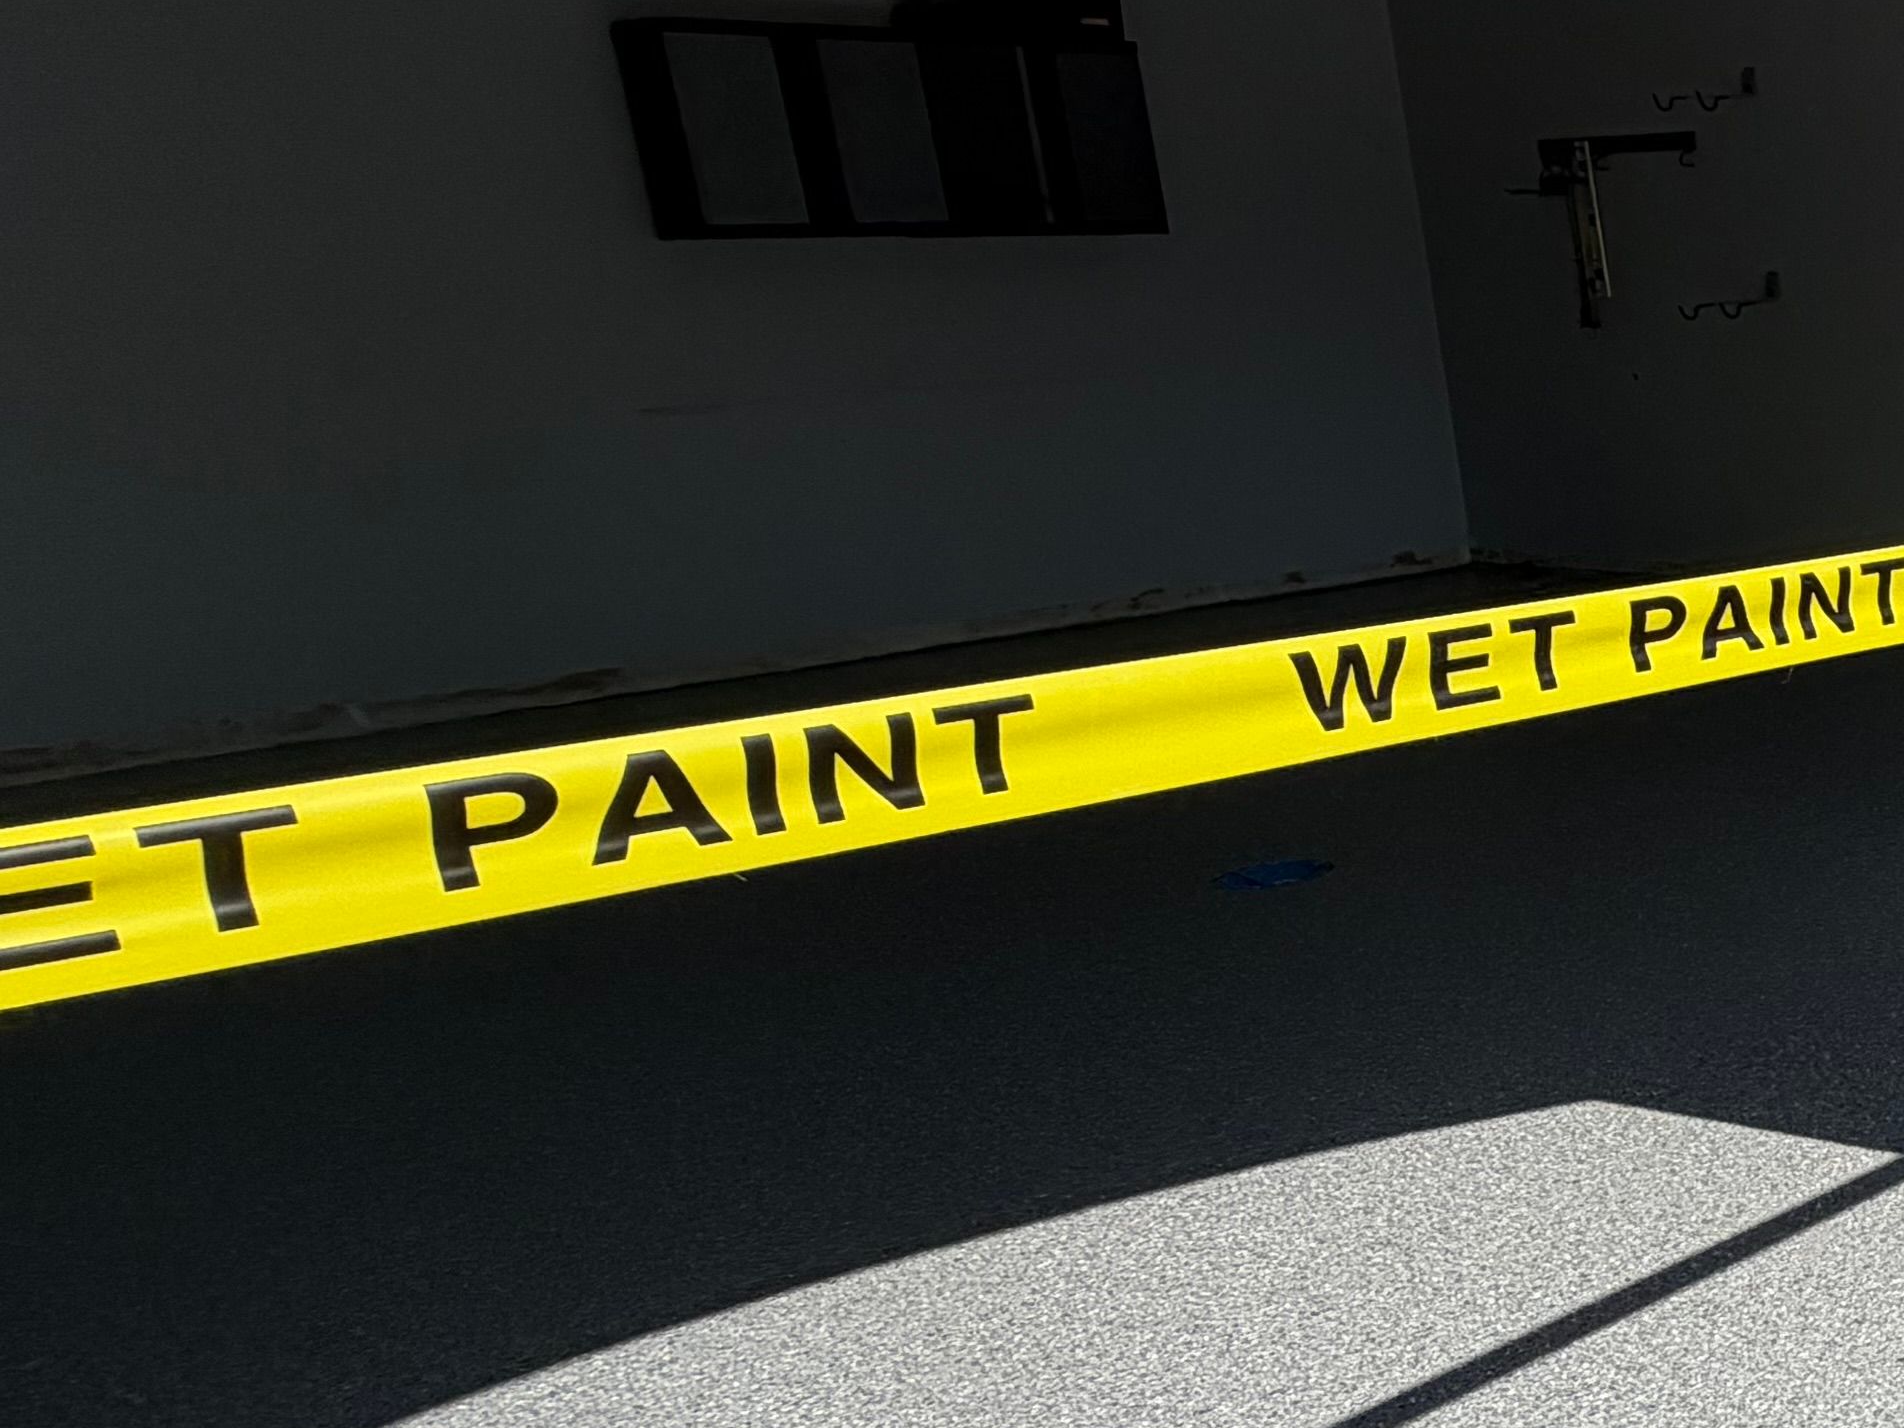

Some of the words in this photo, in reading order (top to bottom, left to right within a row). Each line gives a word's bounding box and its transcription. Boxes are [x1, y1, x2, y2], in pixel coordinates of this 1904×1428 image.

[0, 804, 296, 969] ET
[423, 693, 1033, 892] PAINT
[1288, 610, 1577, 732] WET
